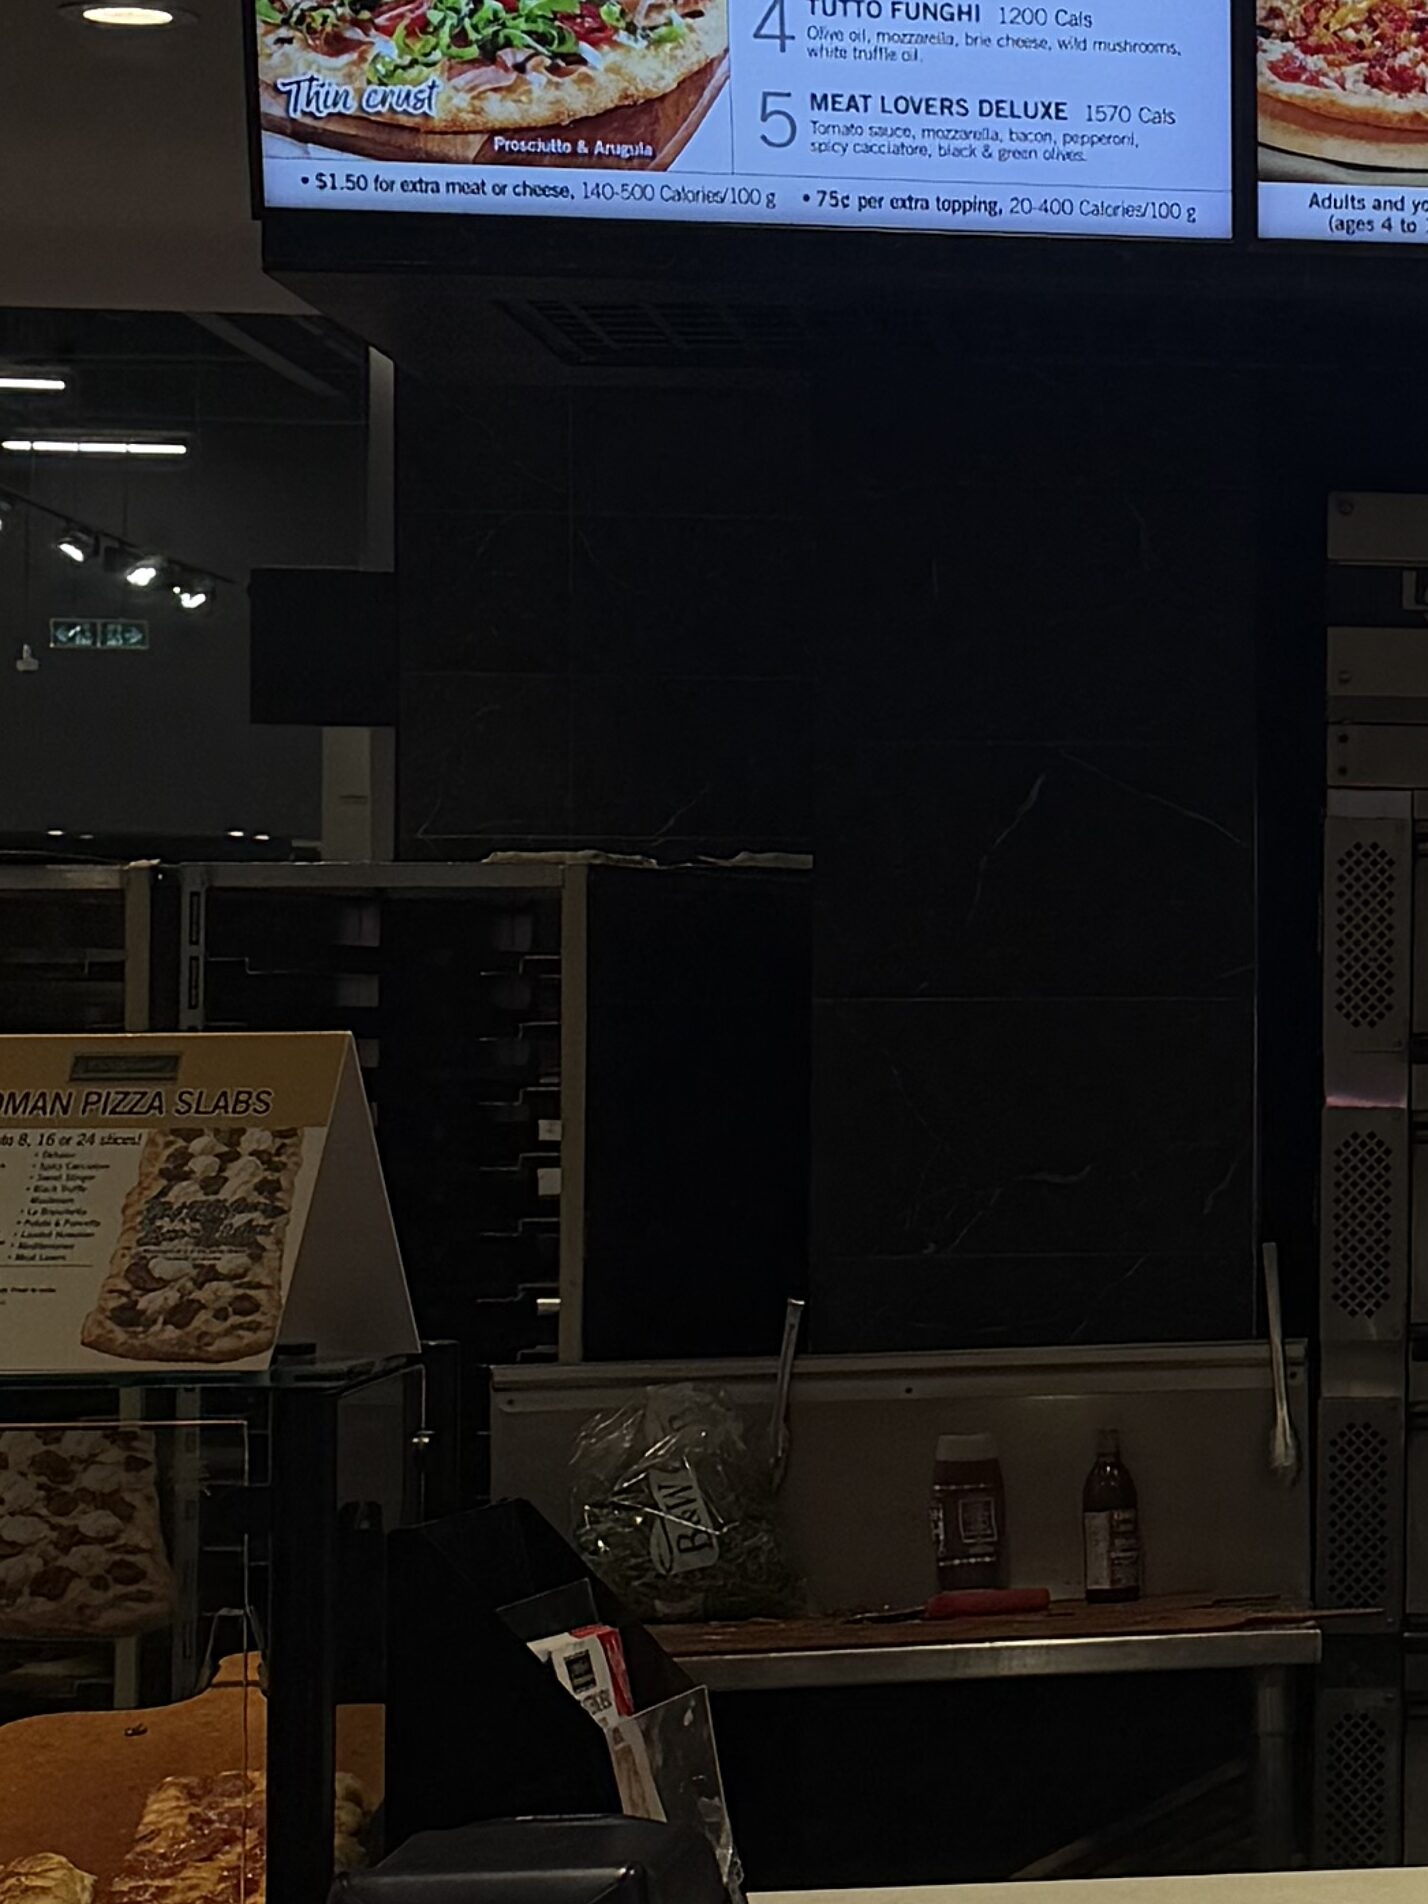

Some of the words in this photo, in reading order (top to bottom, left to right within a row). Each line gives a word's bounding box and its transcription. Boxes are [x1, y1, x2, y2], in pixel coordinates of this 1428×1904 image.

[890, 0, 980, 23] FUNGHI
[999, 6, 1047, 26] 1200
[1054, 8, 1093, 29] Cals
[276, 75, 354, 118] Thin
[363, 78, 439, 115] crust
[809, 92, 872, 113] MEAT
[880, 95, 969, 117] LOVERS
[978, 99, 1068, 121] DELUXE
[1086, 104, 1131, 123] 1570
[1138, 106, 1176, 125] Cals
[759, 91, 797, 148] 5
[493, 135, 572, 155] Prosciutto
[577, 140, 588, 154] &
[594, 140, 653, 159] Arugula
[314, 172, 368, 191] $1.50
[373, 174, 395, 193] for
[399, 177, 440, 194] extra
[445, 179, 487, 196] meat
[491, 182, 508, 197] or
[512, 180, 575, 200] cheese,
[765, 193, 777, 209] g
[81, 1090, 164, 1116] PIZZA
[174, 1090, 273, 1115] SLABS
[37, 1133, 56, 1147] 16
[76, 1133, 96, 1147] 24
